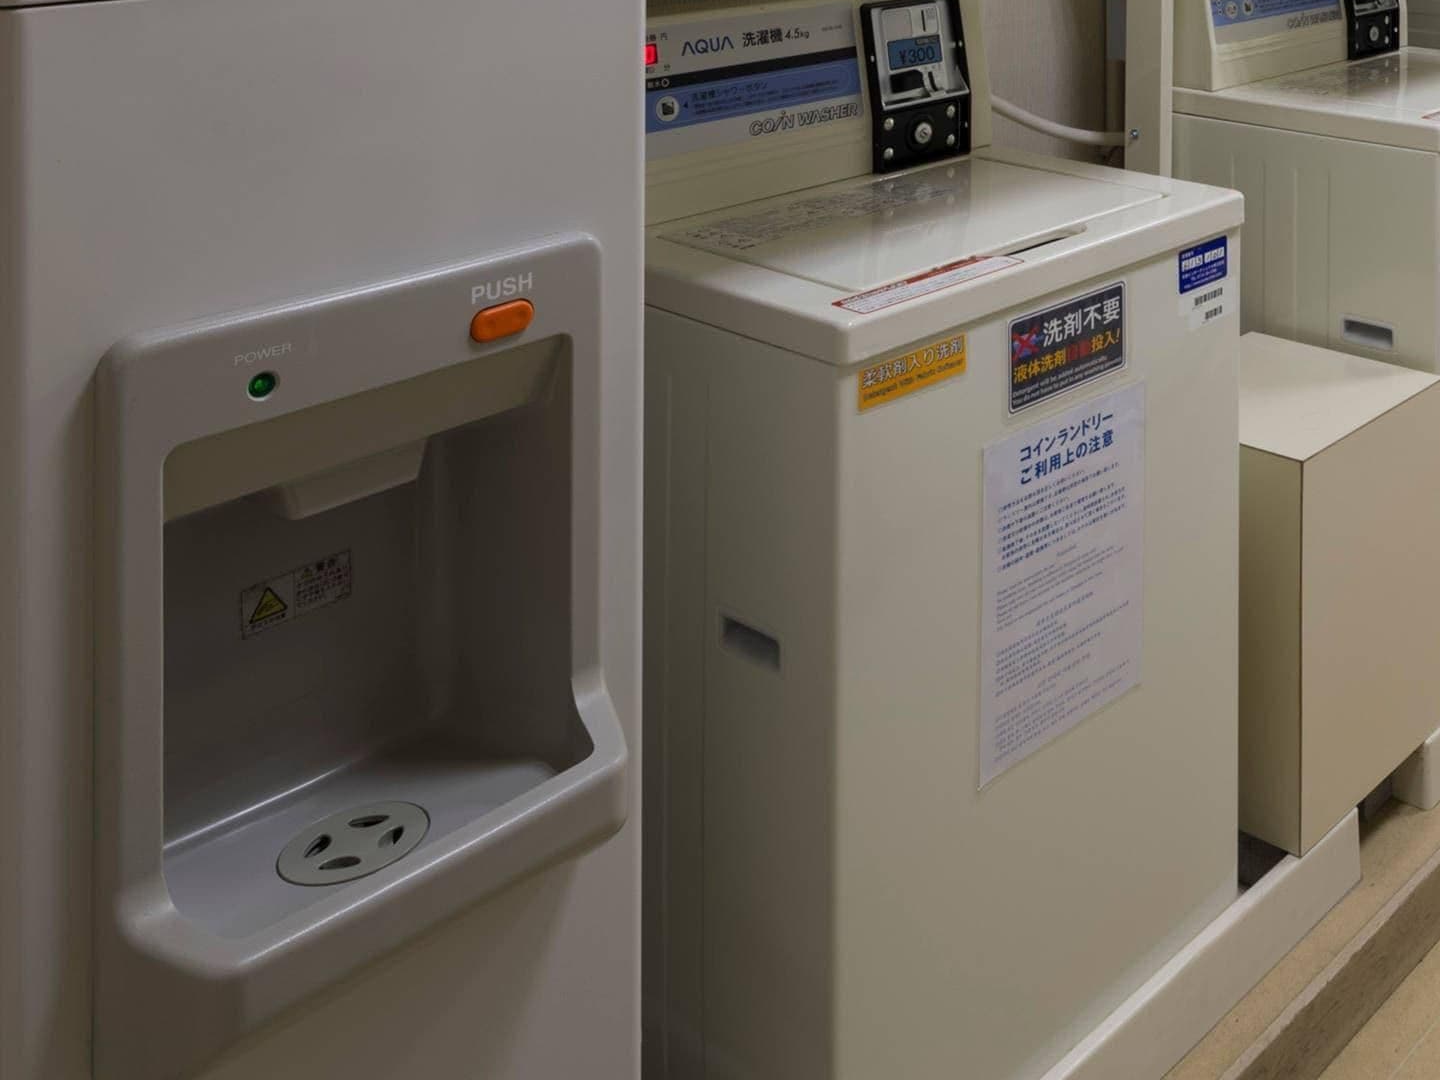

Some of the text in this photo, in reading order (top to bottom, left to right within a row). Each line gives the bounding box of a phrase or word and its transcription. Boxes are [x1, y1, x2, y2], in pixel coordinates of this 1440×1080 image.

[682, 36, 734, 56] AQUA
[742, 28, 784, 47] 洗濯機
[899, 46, 935, 64] ¥300
[750, 111, 795, 136] COIN
[798, 103, 857, 127] WASHER
[471, 272, 533, 304] PUSH
[1042, 296, 1120, 347] 洗剤不要
[234, 343, 292, 366] POWER
[863, 336, 963, 388] 柔軟剤入り洗剤
[1020, 413, 1113, 462] コインランドリー
[1020, 429, 1114, 485] ご利用上の注意
